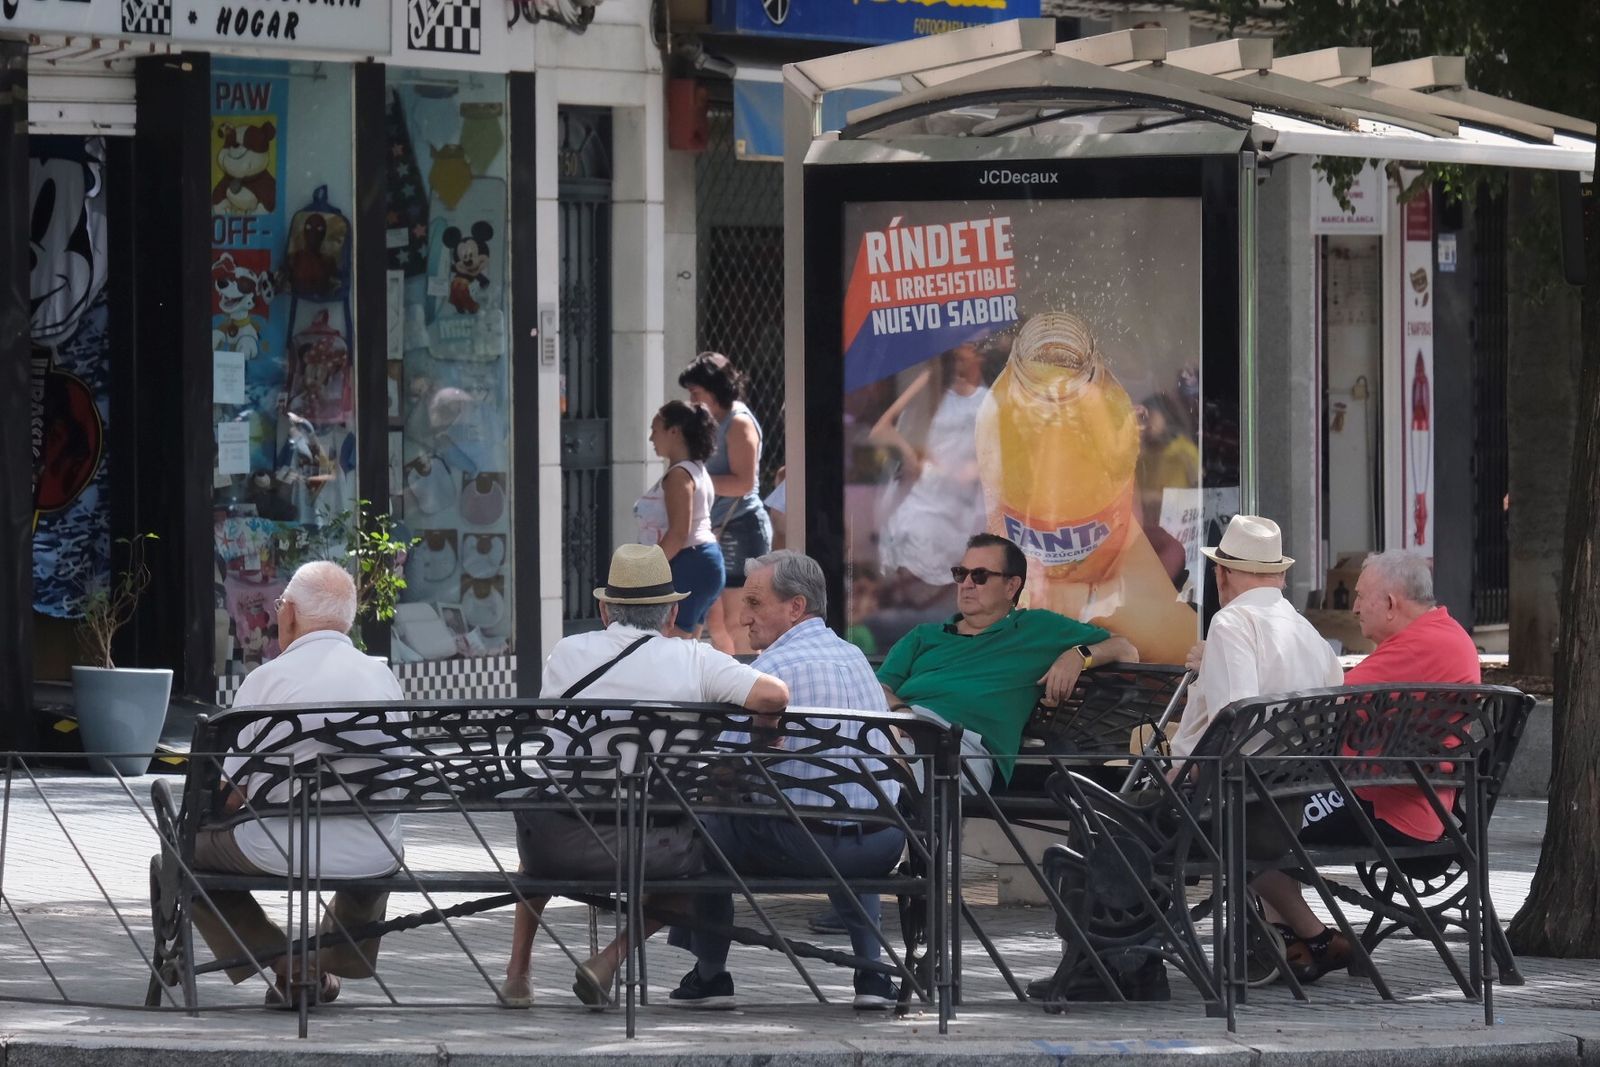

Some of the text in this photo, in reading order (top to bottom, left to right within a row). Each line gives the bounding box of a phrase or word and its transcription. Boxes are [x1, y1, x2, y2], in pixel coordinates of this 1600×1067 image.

[216, 6, 299, 40] HOGAR
[214, 81, 273, 112] PAW
[979, 169, 1059, 185] JCDecaux
[865, 215, 1014, 275] RÍNDETE
[870, 265, 1017, 304] AL IRRESISTIBLE
[872, 295, 1019, 336] NUEVO SABOR
[1003, 514, 1111, 553] FANTA
